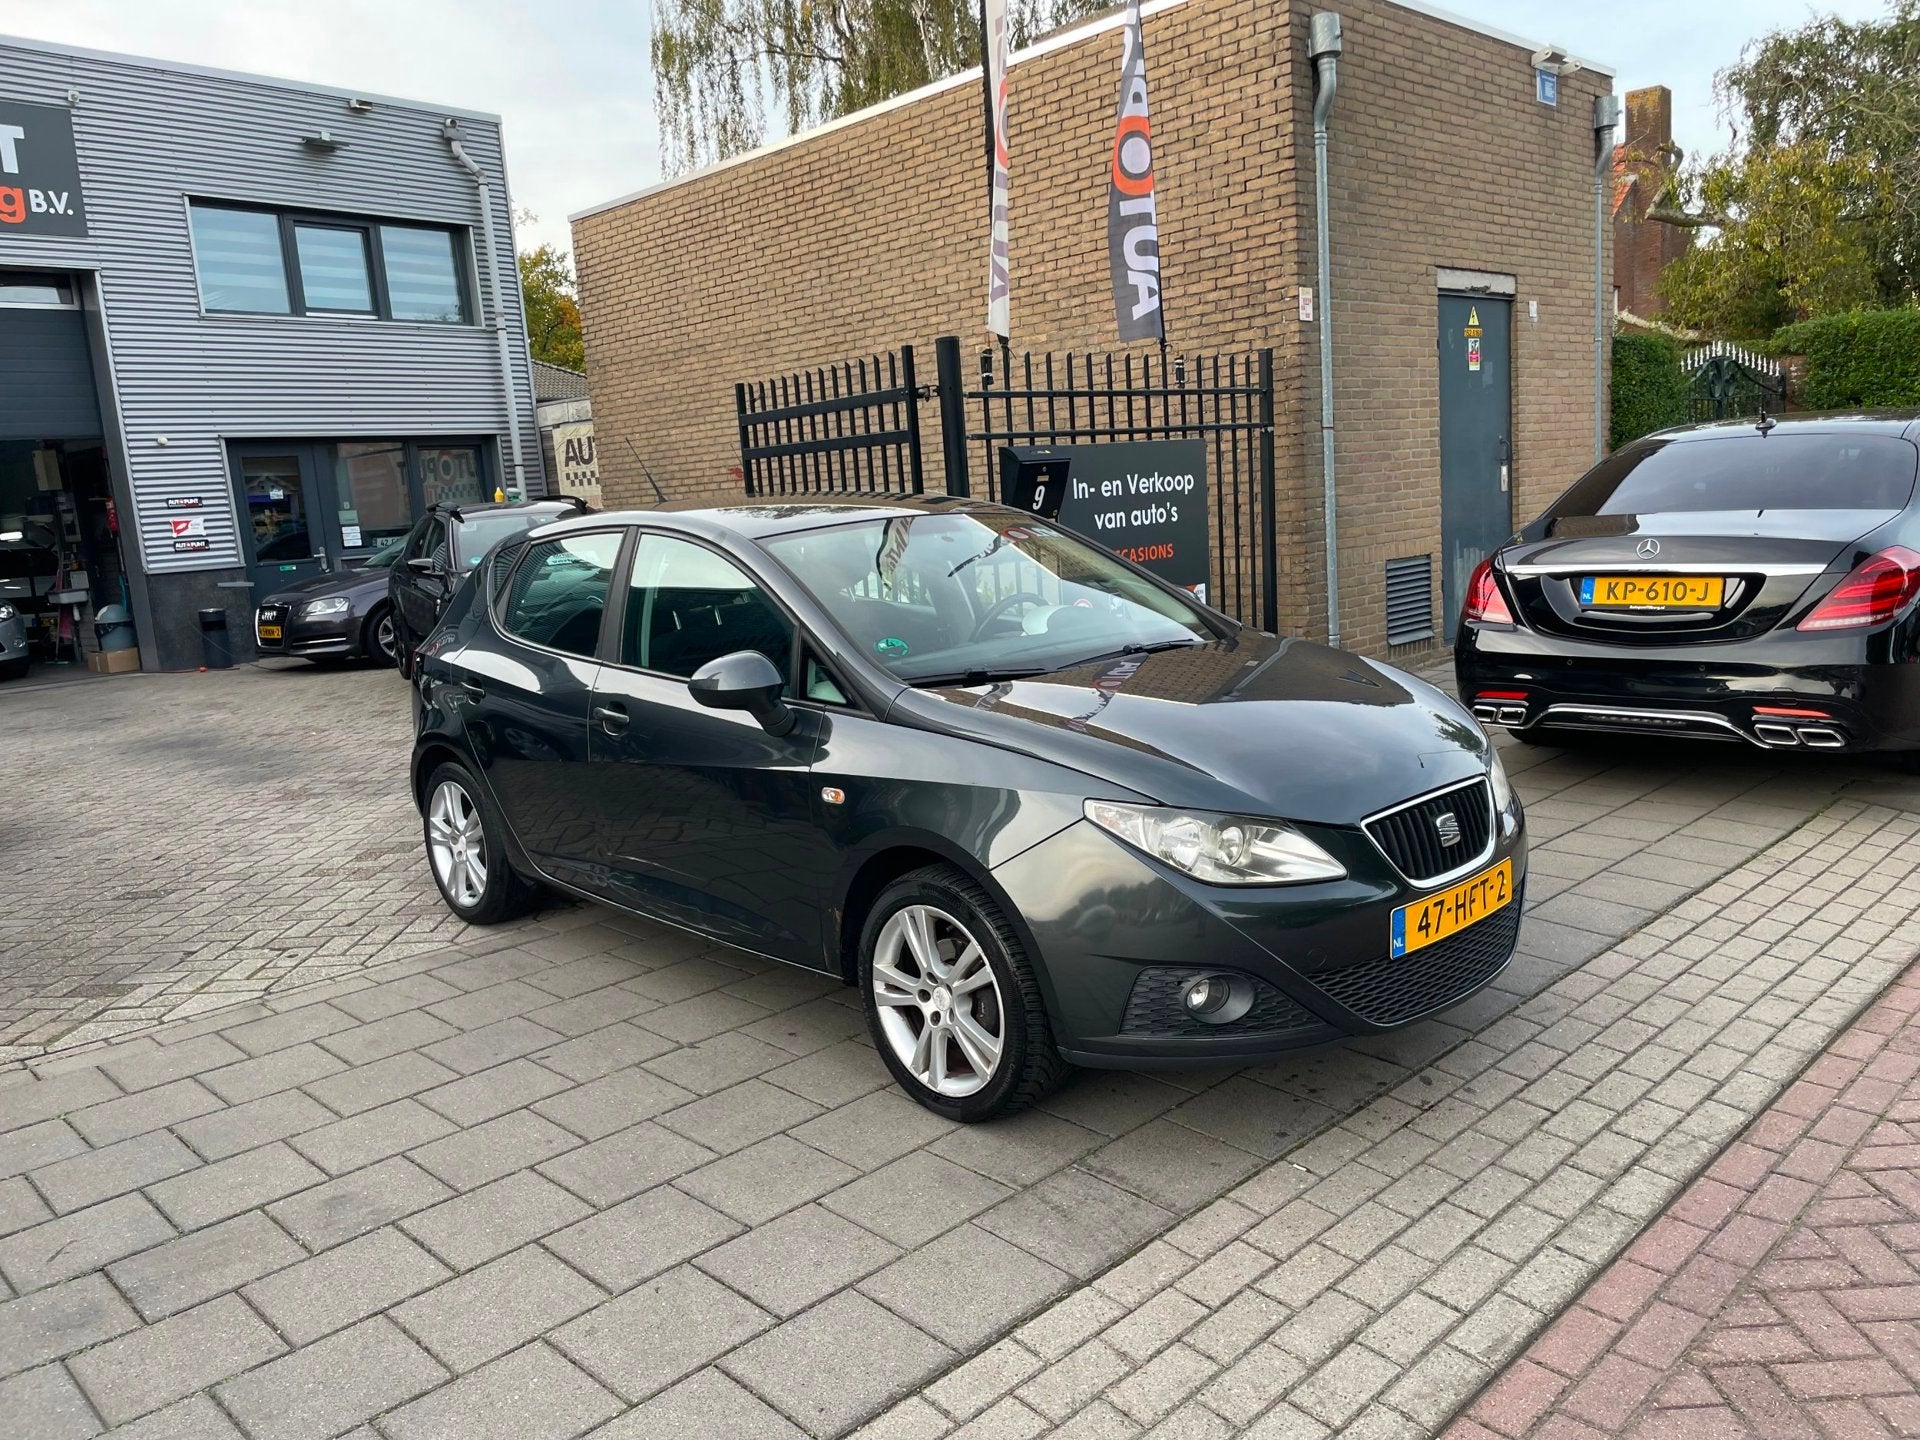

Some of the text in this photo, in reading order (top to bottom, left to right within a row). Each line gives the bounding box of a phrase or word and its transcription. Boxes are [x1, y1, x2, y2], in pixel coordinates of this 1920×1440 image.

[28, 189, 74, 216] B.V.
[564, 436, 596, 468] AU
[1032, 484, 1046, 511] 9
[1073, 471, 1195, 500] In- en Verkoop
[1094, 501, 1179, 530] van auto's
[1606, 581, 1709, 602] KP-610-J
[1417, 870, 1506, 938] 47-HFT-2
[1393, 938, 1404, 948] NL
